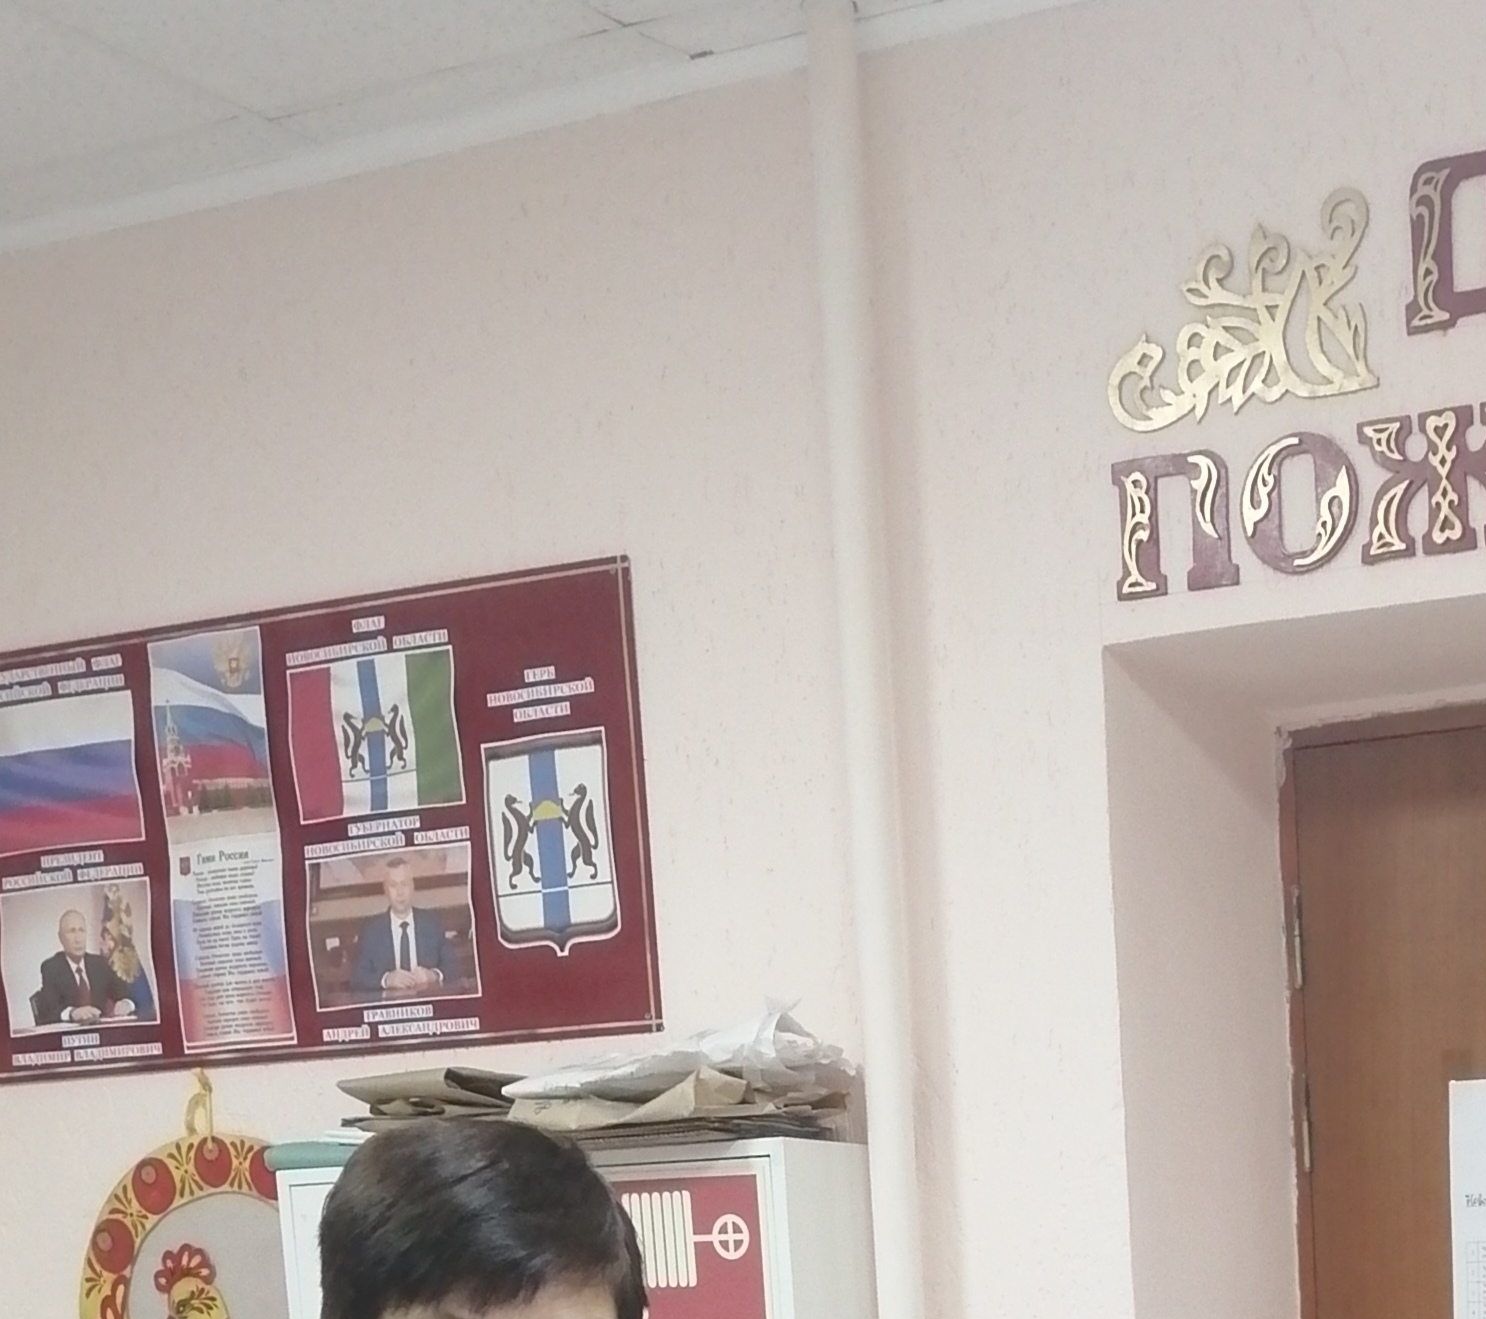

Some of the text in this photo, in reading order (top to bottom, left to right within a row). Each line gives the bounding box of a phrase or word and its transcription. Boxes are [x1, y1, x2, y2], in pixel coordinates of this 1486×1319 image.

[352, 616, 385, 632] ФЛАГ
[287, 630, 448, 665] НОВОСИБИРСКОЙ ОБЛАСТИ
[524, 666, 556, 682] ГЕРБ
[487, 678, 594, 707] НОВОСИБИРСКОЙ
[513, 703, 570, 721] ОБЛАСТИ
[349, 816, 420, 836] ГУБЕРНАТОР
[305, 828, 469, 857] НОВОСИБИРСКОЙ ОБЛАСТИ
[364, 1005, 433, 1022] ТРАВНИКОВ
[323, 1018, 479, 1042] АНДРЕЙ АЛЕКСАНДРОВИЧ
[12, 1043, 162, 1066] ВЛАДИМИР ВЛАДИМИРОВИЧ
